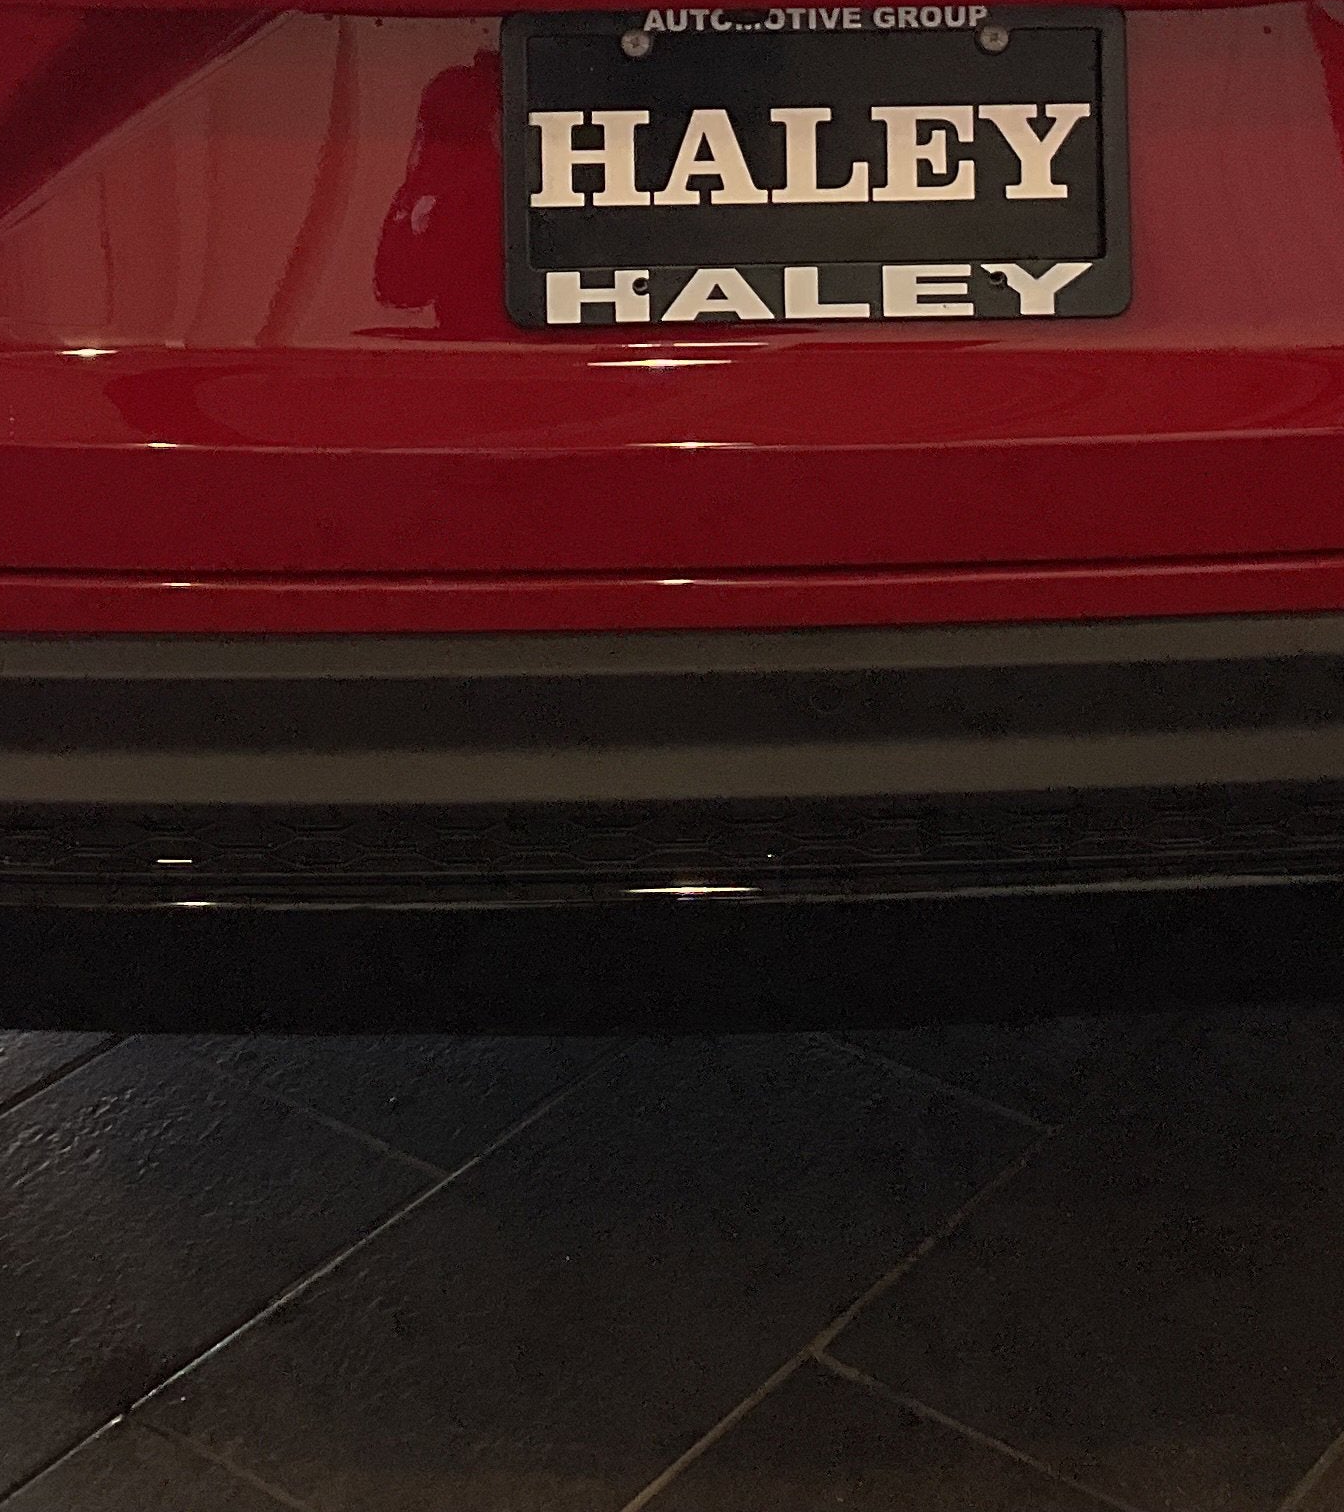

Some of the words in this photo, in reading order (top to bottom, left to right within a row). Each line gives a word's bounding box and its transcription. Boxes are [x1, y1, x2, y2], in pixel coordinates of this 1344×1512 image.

[873, 5, 988, 29] GROUP
[528, 103, 1092, 208] HALEY
[545, 262, 1094, 324] HALEY
